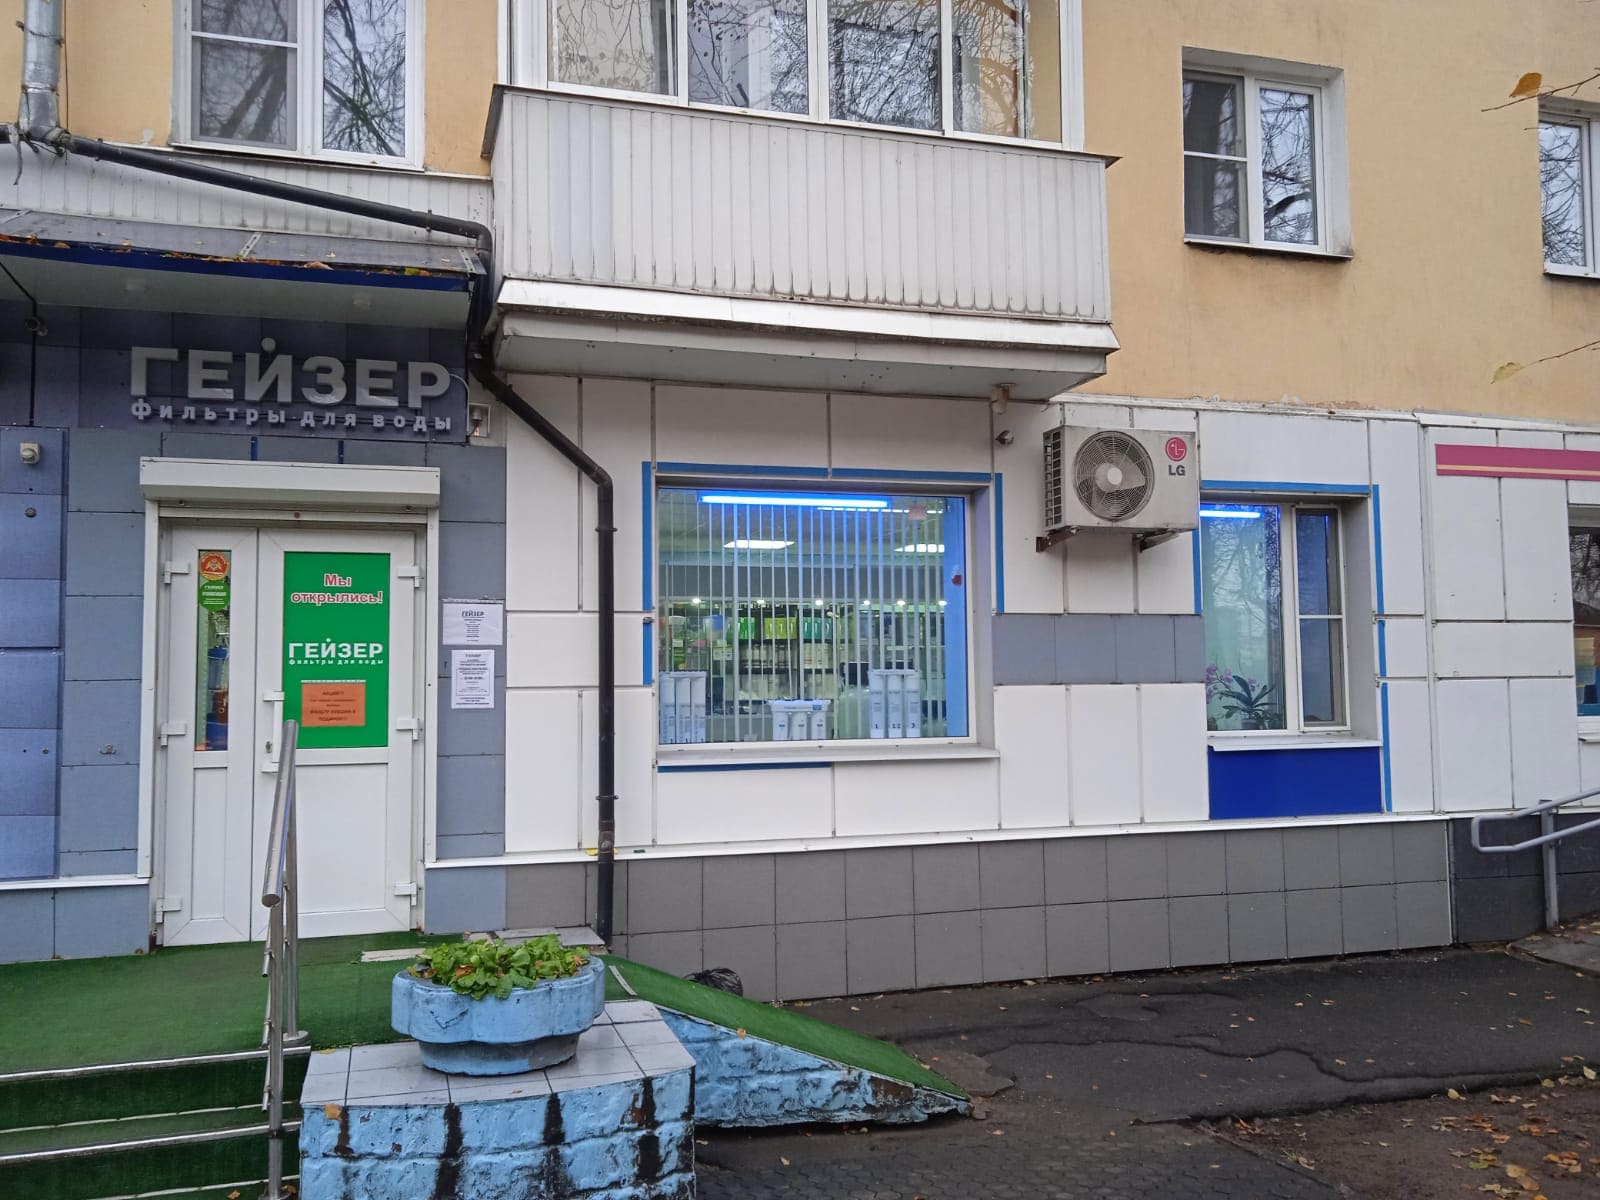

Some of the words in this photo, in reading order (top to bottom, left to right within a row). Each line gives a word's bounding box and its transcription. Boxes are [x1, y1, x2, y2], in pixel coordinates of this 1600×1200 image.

[130, 337, 450, 408] ГЕЙЗЕР
[131, 398, 286, 425] фильтры
[300, 410, 357, 427] для
[372, 413, 452, 432] воды
[1168, 464, 1186, 476] LG
[324, 573, 351, 587] Мы
[290, 590, 384, 606] открылись!
[288, 637, 384, 658] ГЕЙЗЕР
